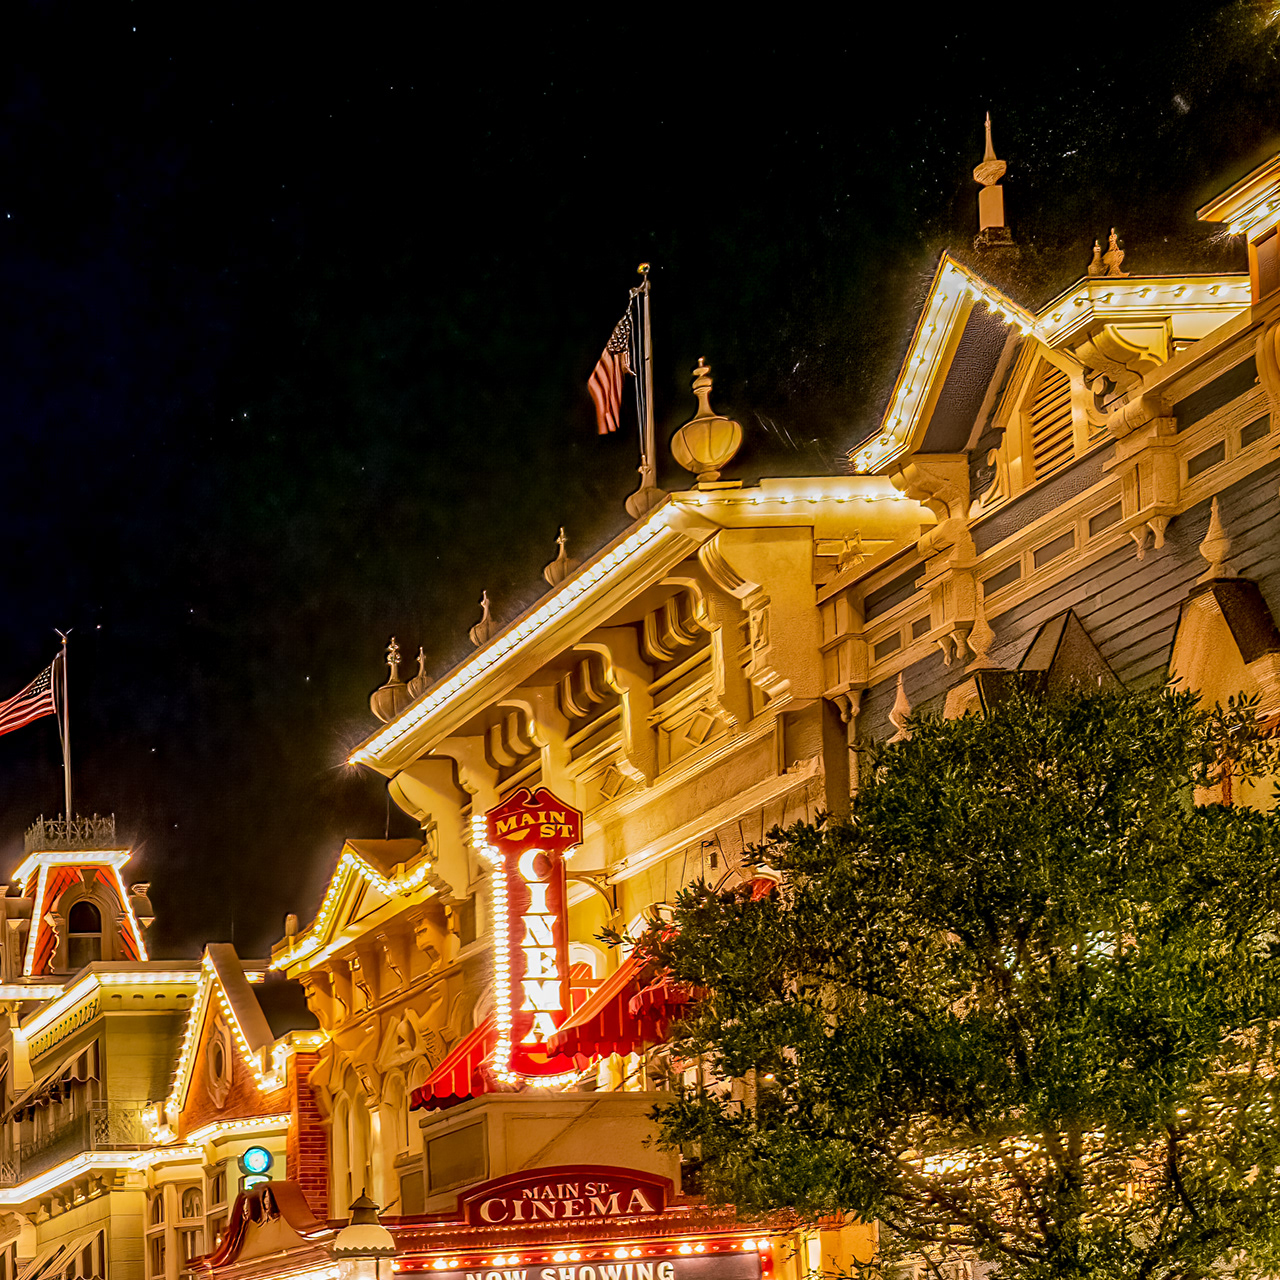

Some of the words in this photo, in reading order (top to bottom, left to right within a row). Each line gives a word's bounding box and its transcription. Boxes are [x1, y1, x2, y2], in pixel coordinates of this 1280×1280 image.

[496, 810, 566, 836] MAIN
[539, 824, 575, 838] ST.
[518, 848, 563, 1044] CINEMA
[480, 1188, 656, 1224] CINEMA
[522, 1182, 579, 1200] MAIN
[584, 1181, 613, 1196] ST.
